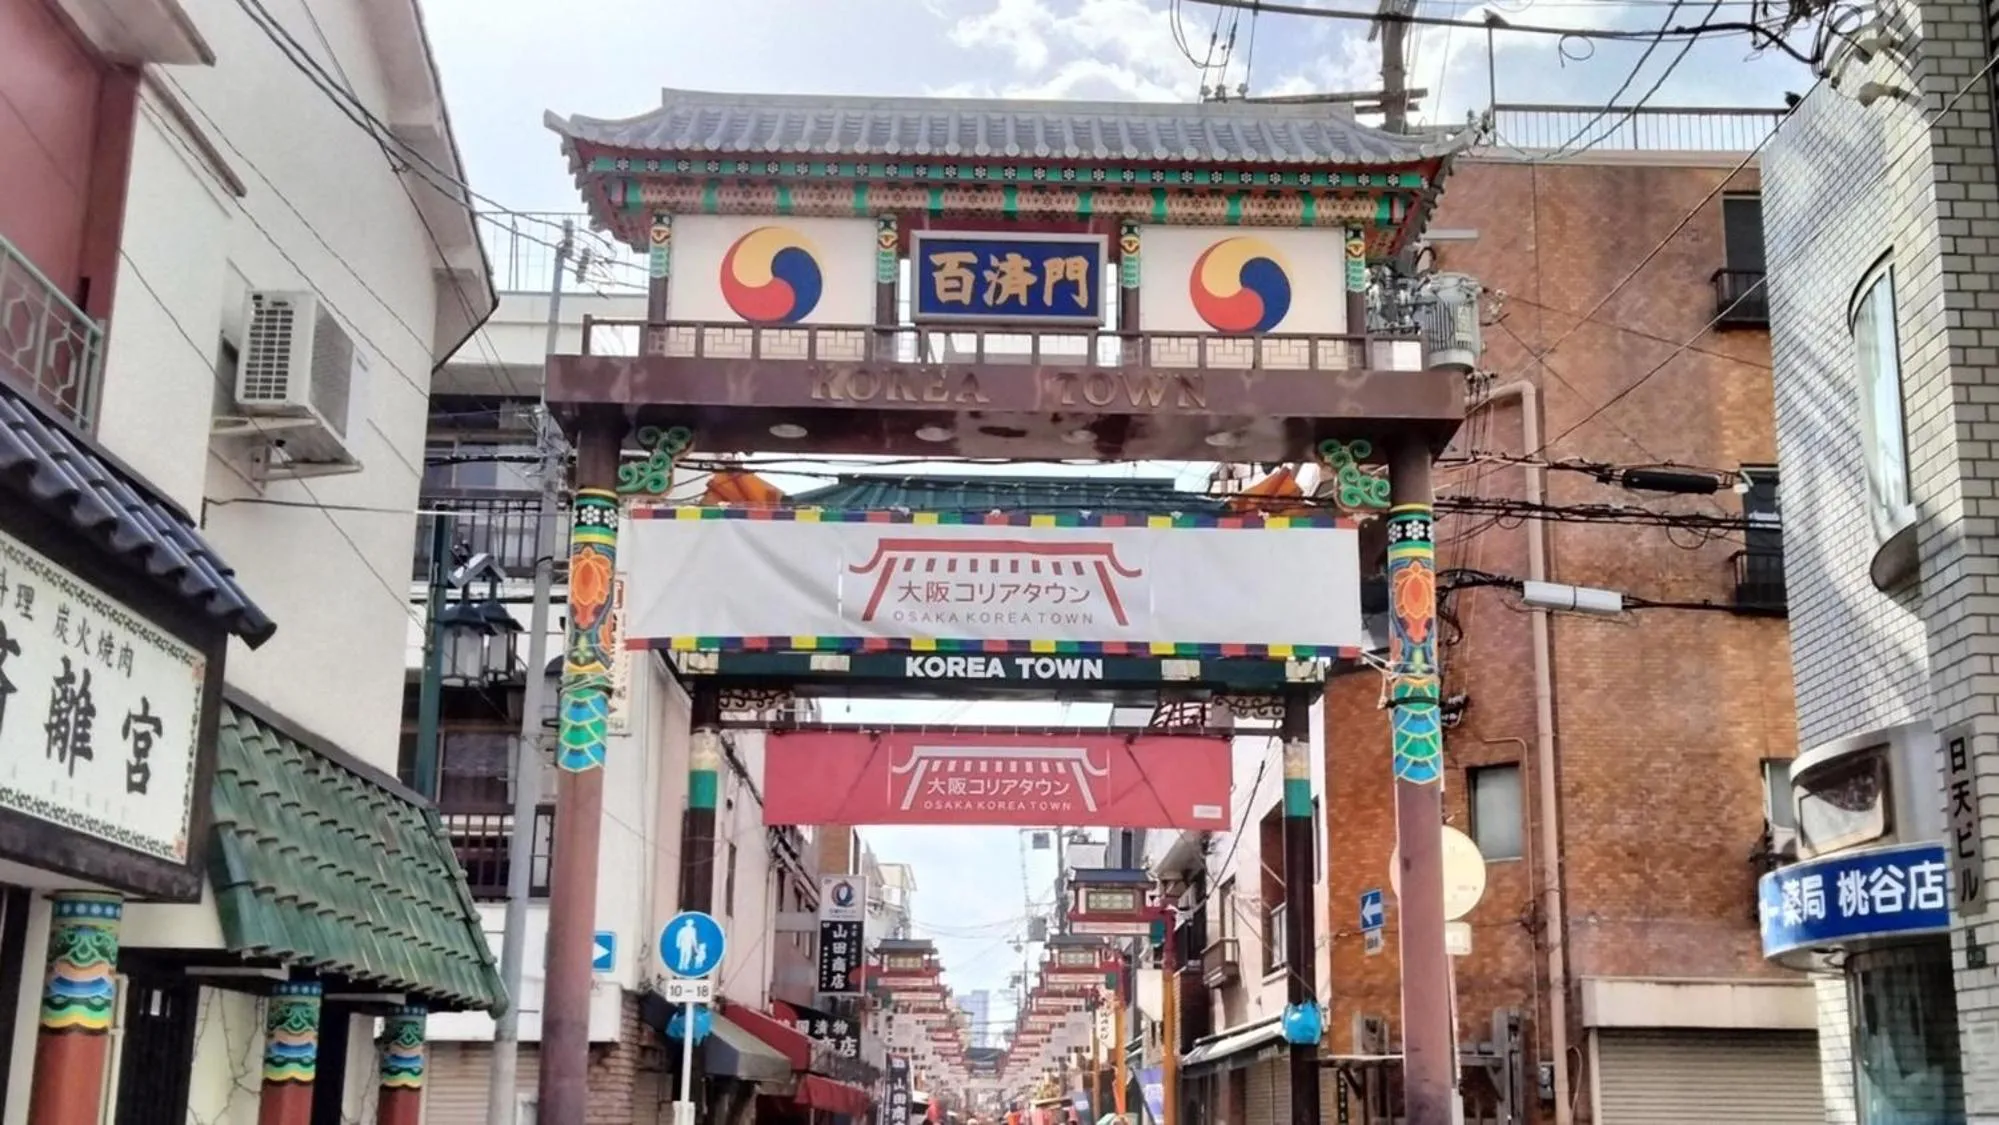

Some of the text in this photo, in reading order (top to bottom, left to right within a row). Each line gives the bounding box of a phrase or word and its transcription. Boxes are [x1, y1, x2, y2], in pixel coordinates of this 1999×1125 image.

[810, 366, 1208, 410] KOREA TOWN
[898, 582, 1091, 604] 大阪コリアタウン
[893, 611, 1094, 625] OSAKA KOREA TOWN
[905, 657, 1103, 680] KOREA TOWN
[0, 619, 163, 795] 離宮
[926, 777, 1070, 797] 大阪コリアタウン
[924, 800, 1072, 811] OSAKA KOREA TOWN
[1950, 736, 1979, 901] 日天ビル
[1836, 859, 1946, 918] 桃谷店
[891, 1077, 907, 1125] 山田商
